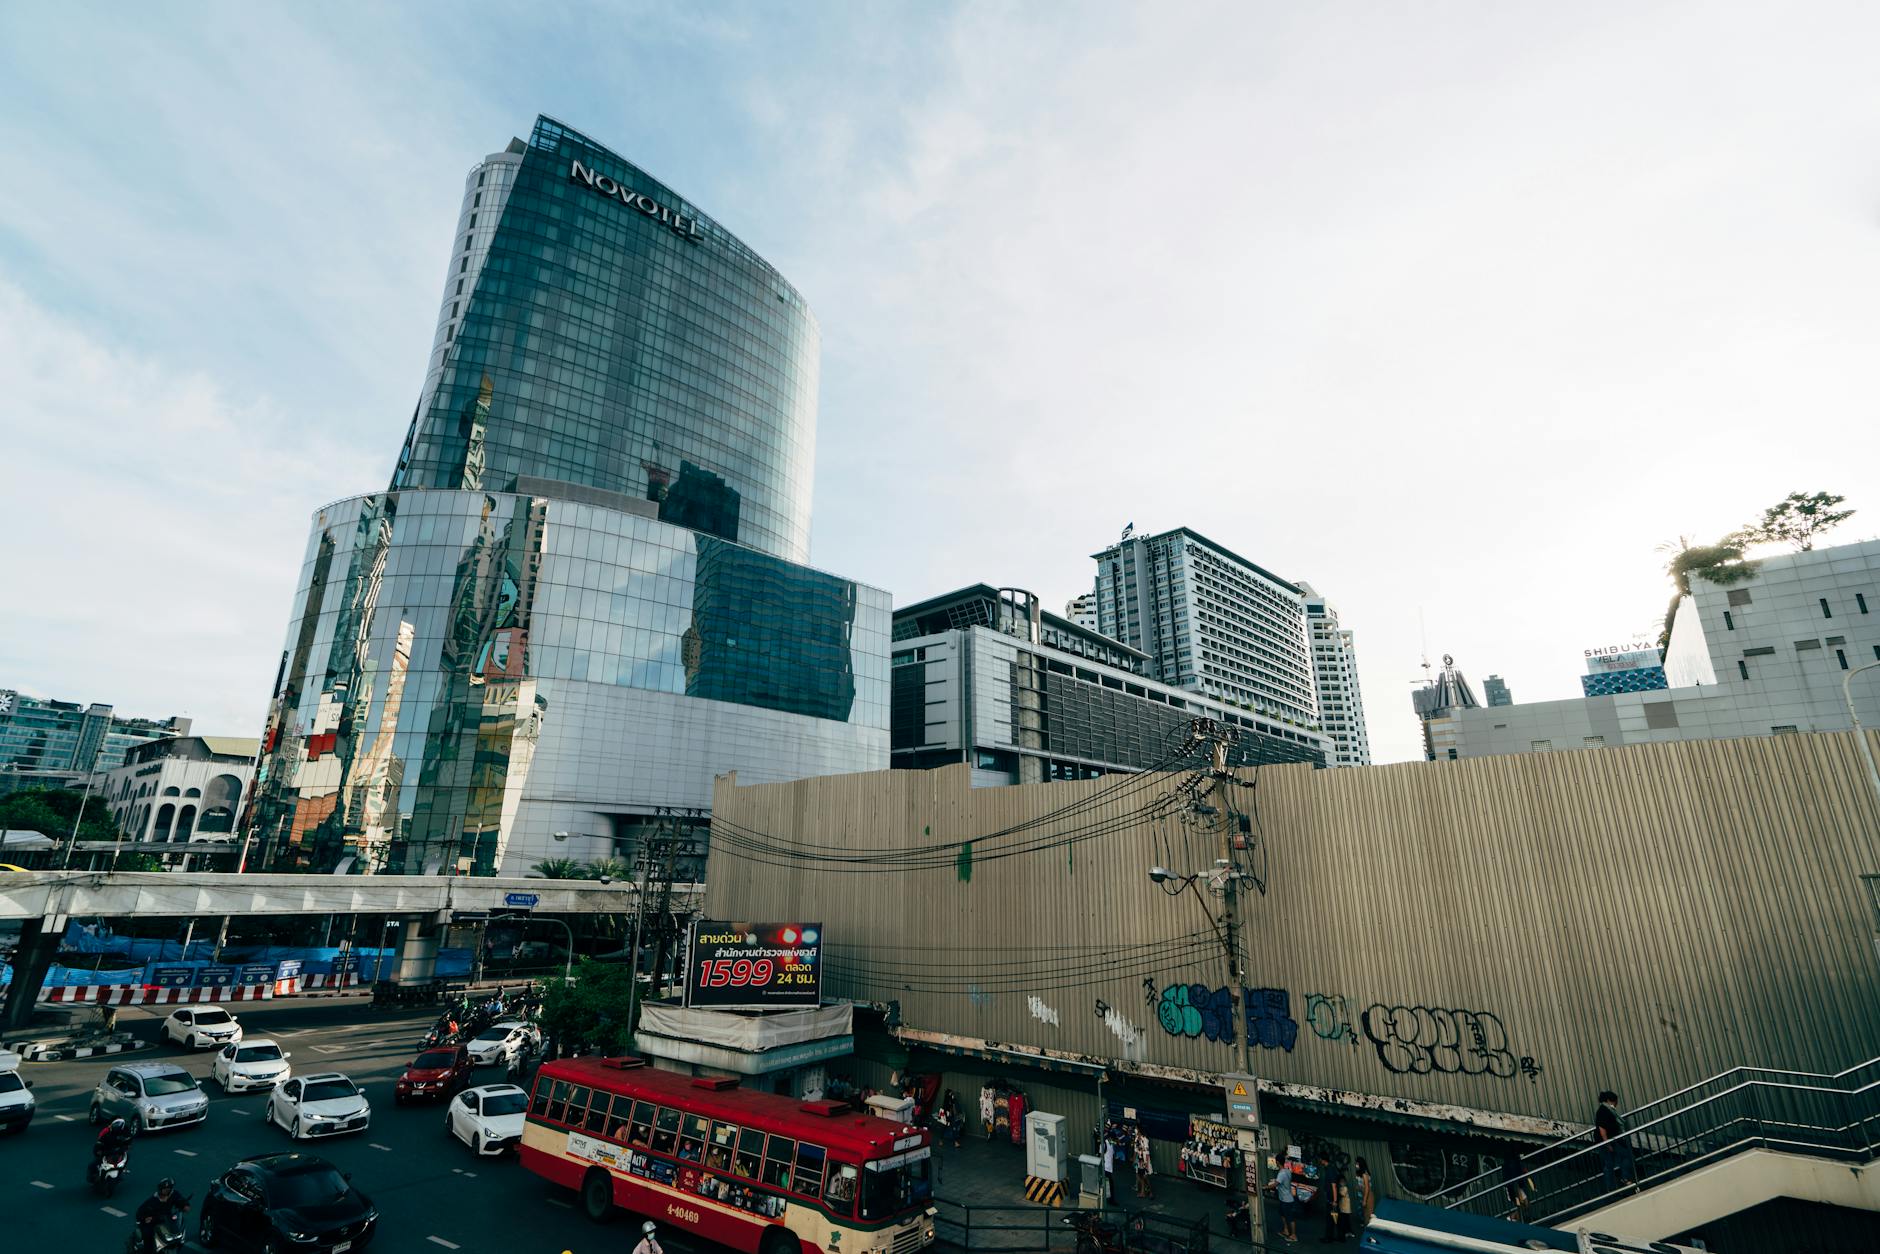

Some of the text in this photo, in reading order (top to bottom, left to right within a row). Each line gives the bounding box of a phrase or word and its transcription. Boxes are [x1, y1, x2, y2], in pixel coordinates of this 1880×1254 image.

[571, 159, 704, 241] NOVOTEL
[1584, 642, 1652, 657] SHIBUYA
[699, 931, 742, 944] สายด่วน
[714, 947, 817, 958] สำนักงานตำรวจแห่งชาติ
[699, 958, 774, 987] 1599
[785, 963, 812, 972] ตลอด
[777, 973, 816, 984] 24 ชม.
